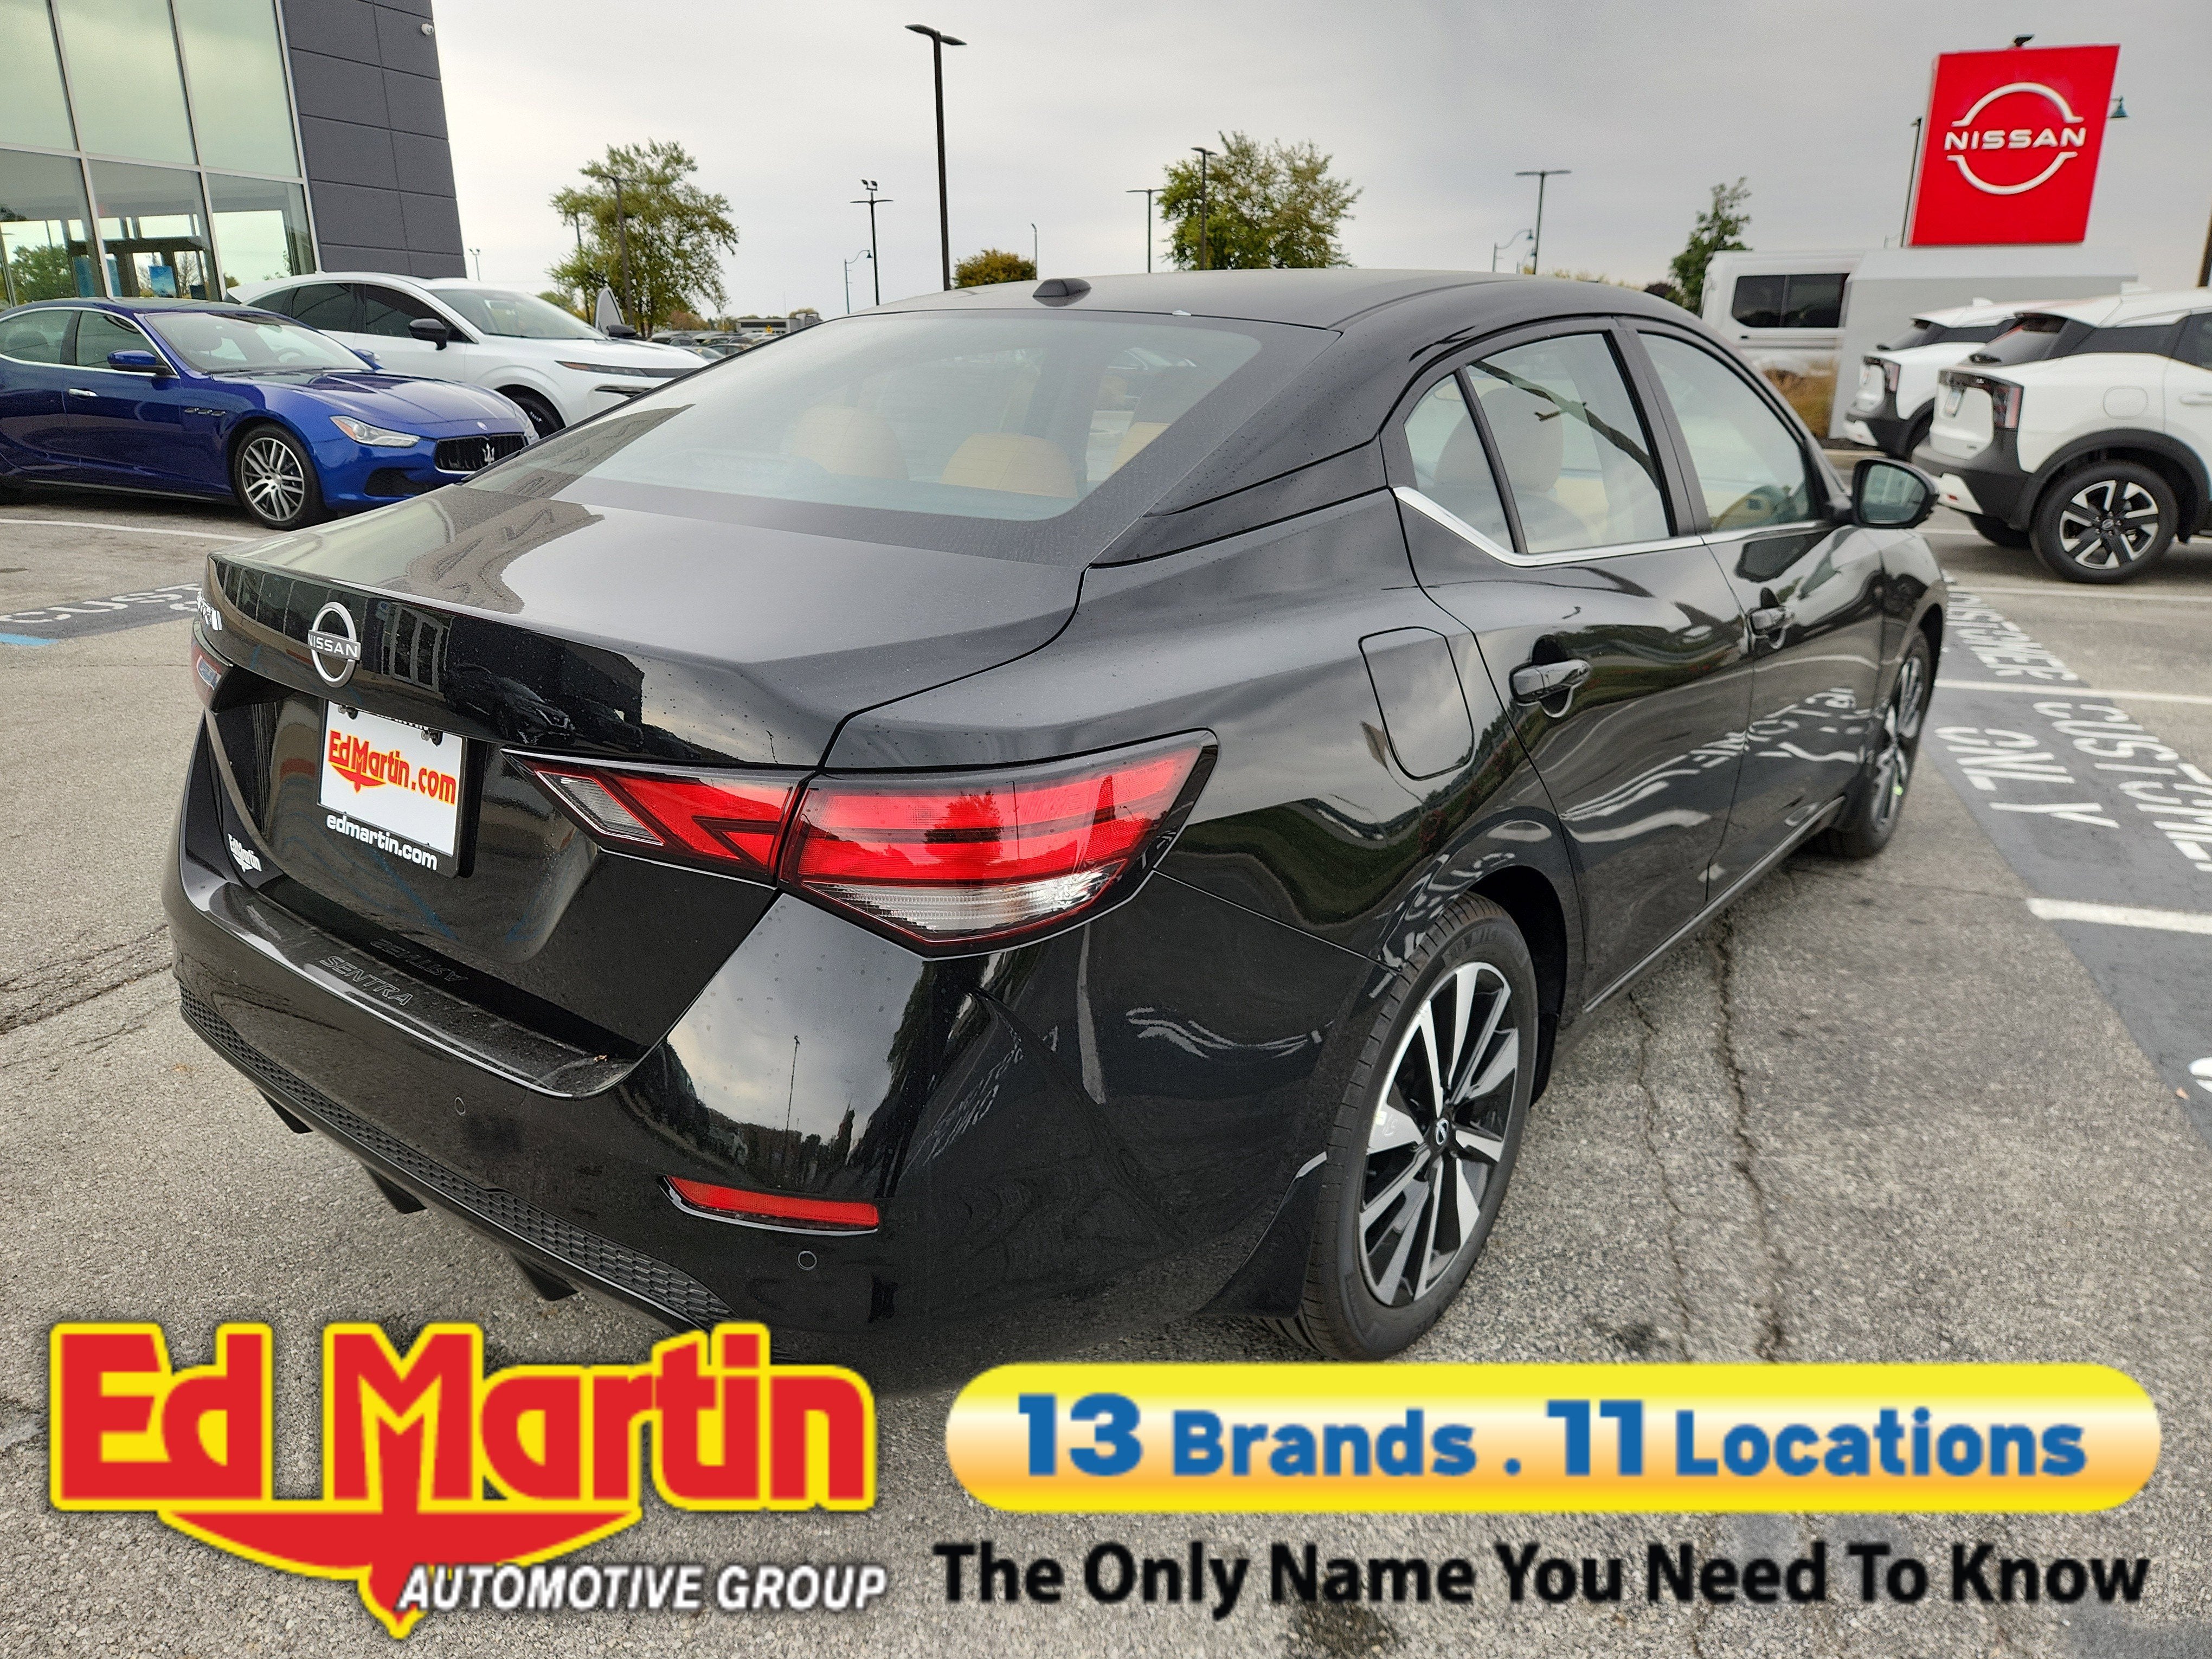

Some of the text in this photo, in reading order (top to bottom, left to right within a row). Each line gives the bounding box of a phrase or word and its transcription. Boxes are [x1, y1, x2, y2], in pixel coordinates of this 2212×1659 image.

[1944, 127, 2086, 151] NISSAN
[307, 633, 358, 658] NISSAN
[1934, 726, 2119, 828] ONLY
[326, 814, 438, 871] edmartin.com
[319, 956, 413, 1006] SENTRA
